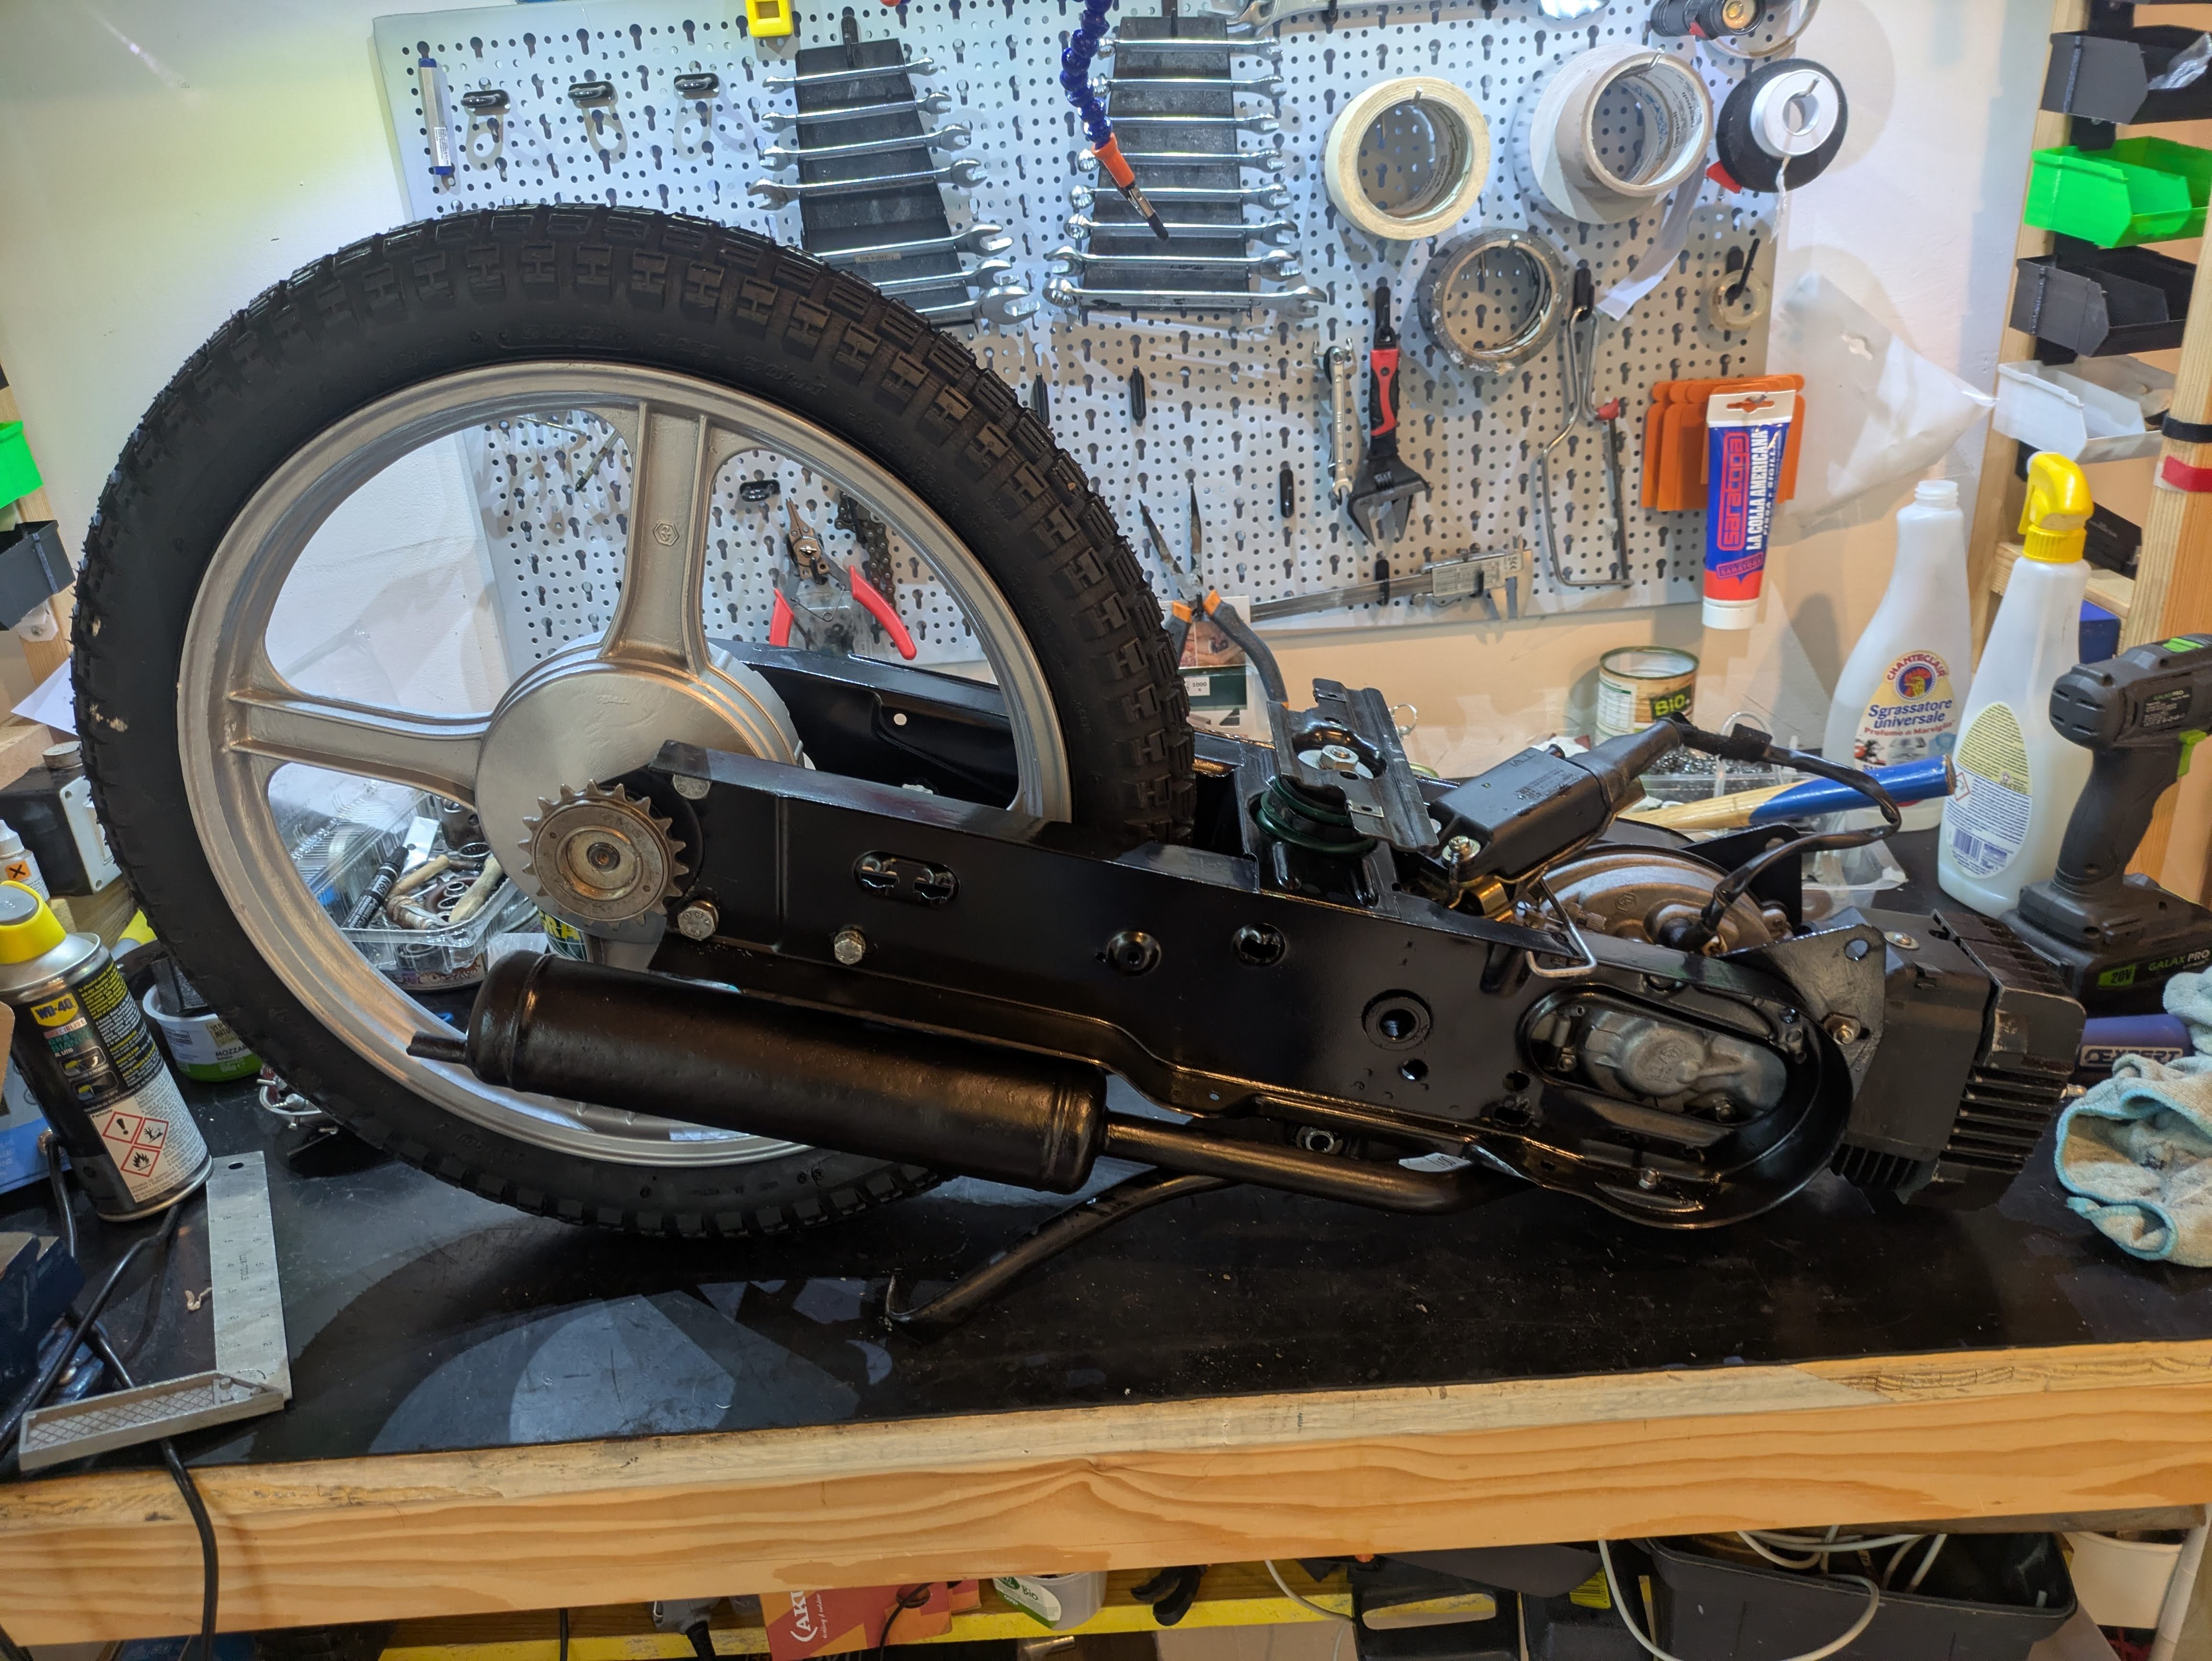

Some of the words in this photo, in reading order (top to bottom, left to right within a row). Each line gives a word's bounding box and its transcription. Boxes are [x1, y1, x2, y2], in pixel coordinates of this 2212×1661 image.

[1749, 430, 1769, 497] AMERICANA
[1724, 436, 1747, 545] saratoga
[1747, 498, 1767, 534] COLLA
[1746, 534, 1763, 550] LA
[1887, 653, 1946, 680] CHANTECLAIR
[1654, 695, 1685, 716] BIO
[1869, 699, 1952, 720] Sgrassatore
[1864, 727, 1903, 736] Profumo
[1913, 721, 1953, 735] Marsiglia
[1873, 711, 1945, 729] universale
[2148, 956, 2185, 971] GALAX
[2187, 949, 2210, 962] PRO
[35, 998, 74, 1019] WD-40
[1021, 1584, 1039, 1601] Bio
